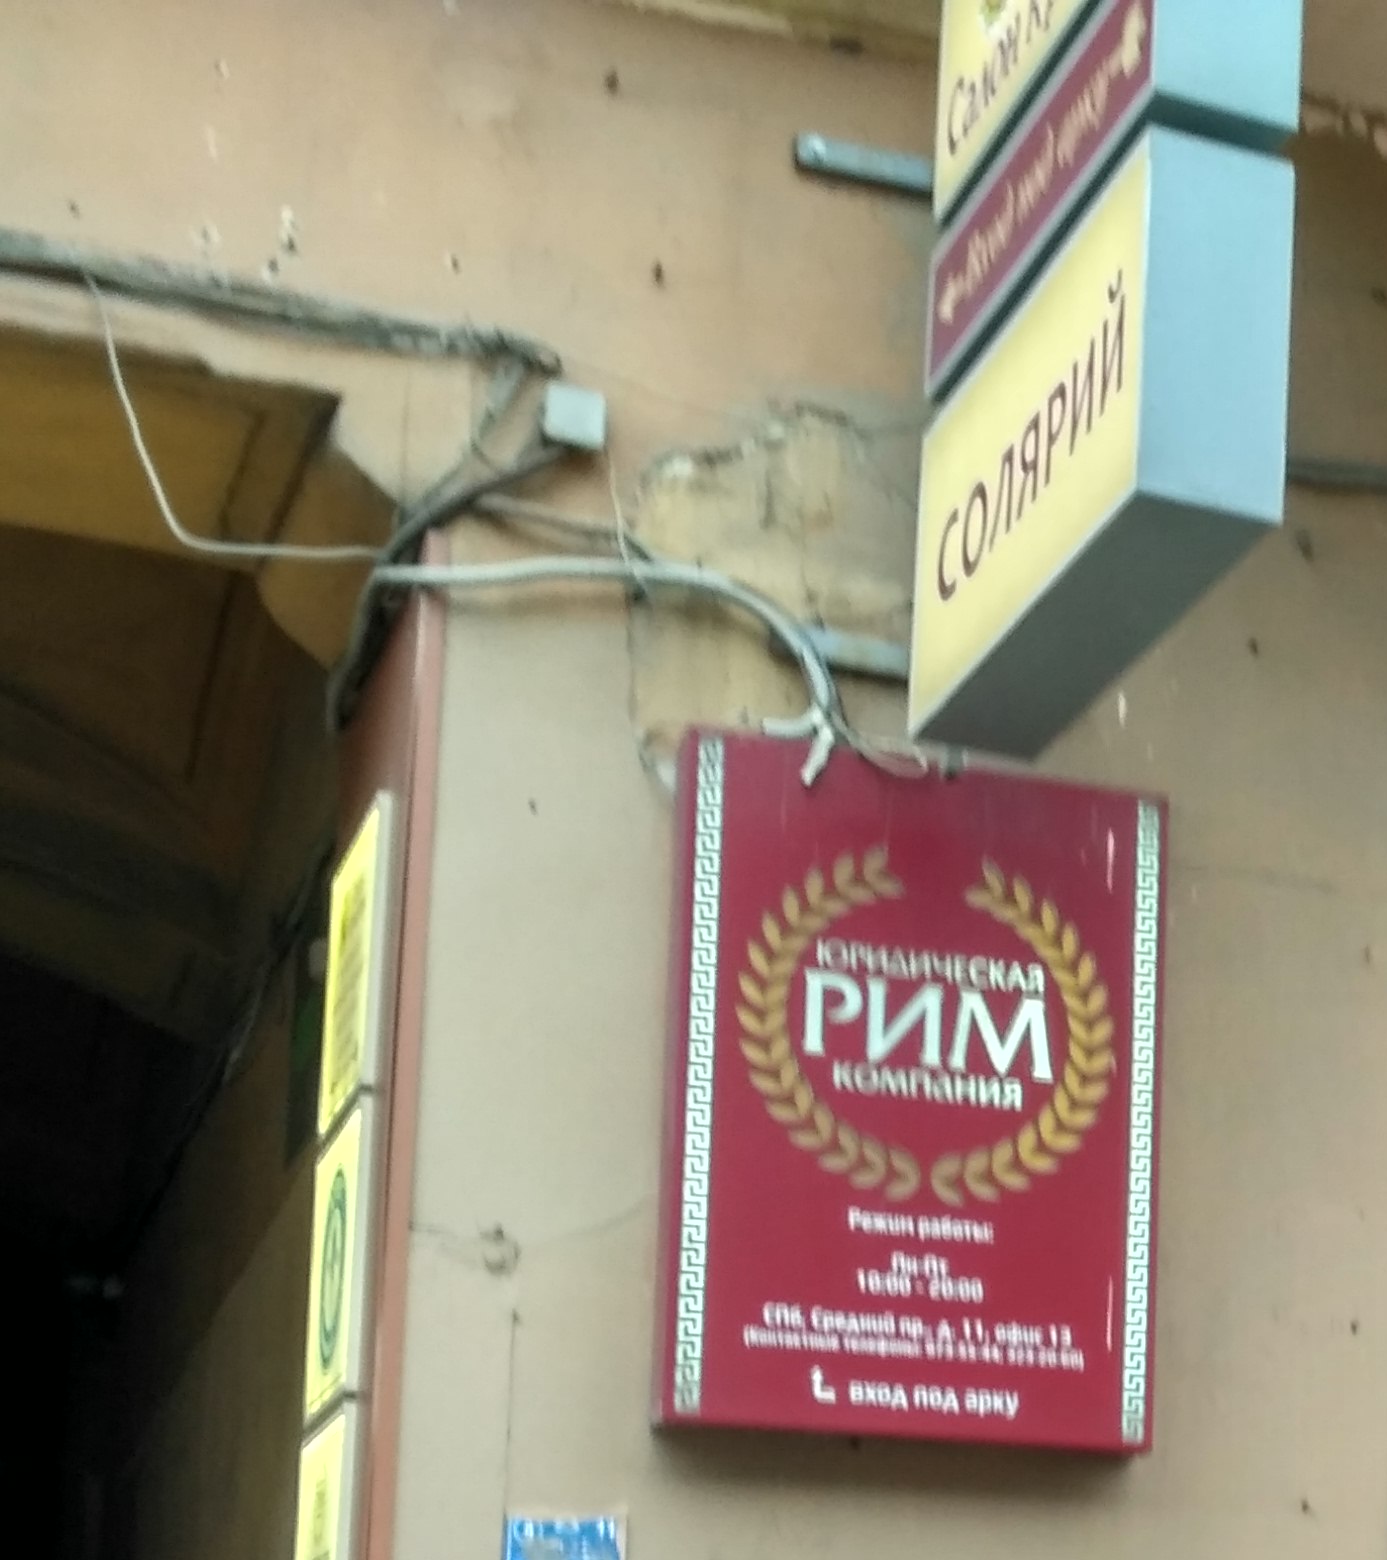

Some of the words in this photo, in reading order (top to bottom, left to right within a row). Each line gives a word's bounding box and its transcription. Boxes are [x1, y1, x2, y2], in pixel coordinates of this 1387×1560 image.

[935, 268, 1127, 602] СОЛЯРИЙ
[815, 938, 1044, 994] ЮРИДИЧЕСКАЯ
[802, 967, 1054, 1084] РИМ
[832, 1061, 1023, 1112] КОМПАНИЯ
[848, 1380, 908, 1411] вход
[913, 1385, 960, 1415] под
[964, 1389, 1020, 1421] арку
